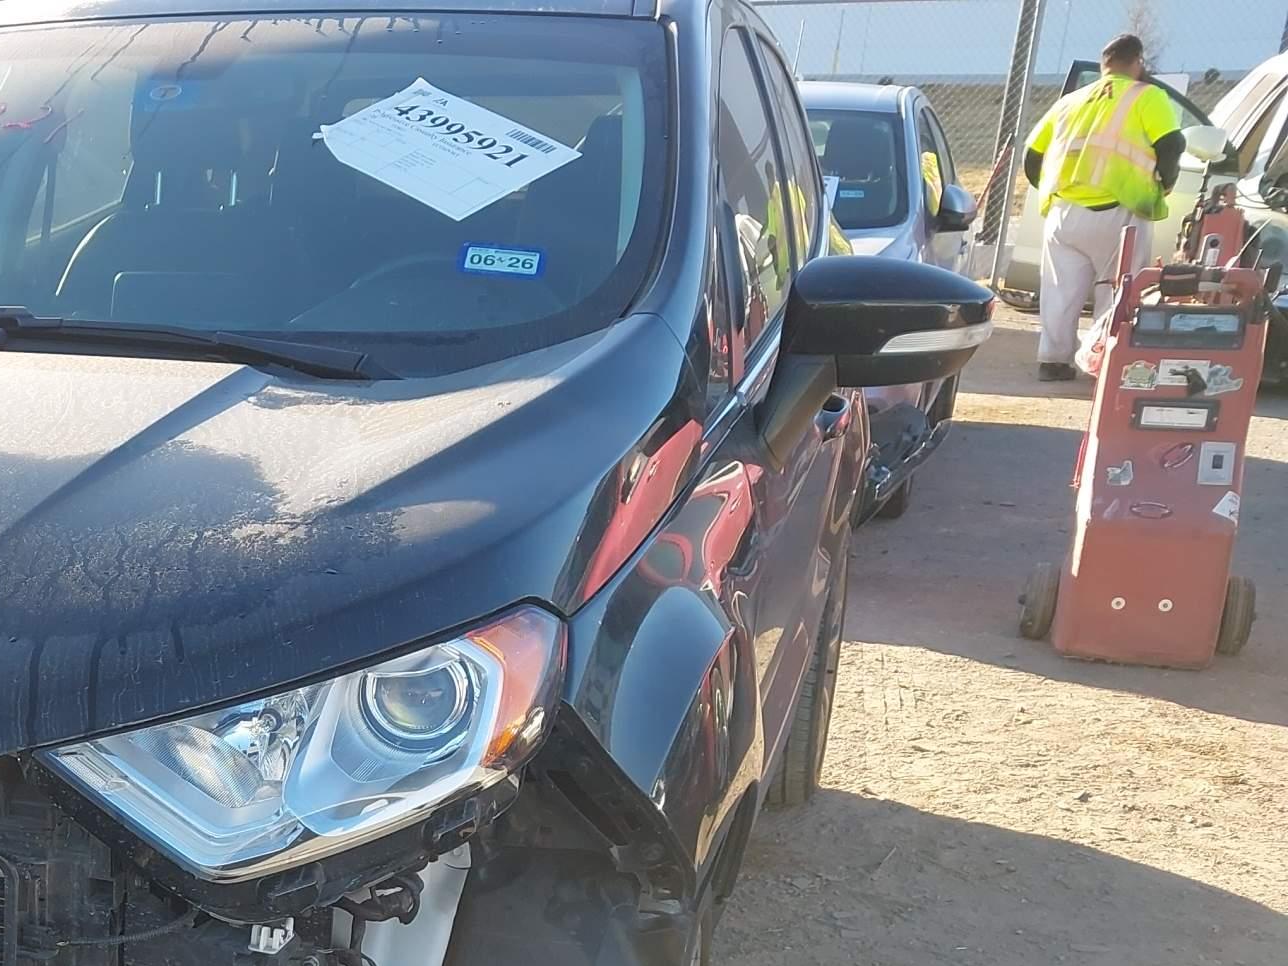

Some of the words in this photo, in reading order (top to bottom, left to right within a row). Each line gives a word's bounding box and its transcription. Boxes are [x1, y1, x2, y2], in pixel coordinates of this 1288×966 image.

[393, 103, 530, 168] 43995921
[469, 253, 496, 266] 06
[507, 256, 535, 270] 26
